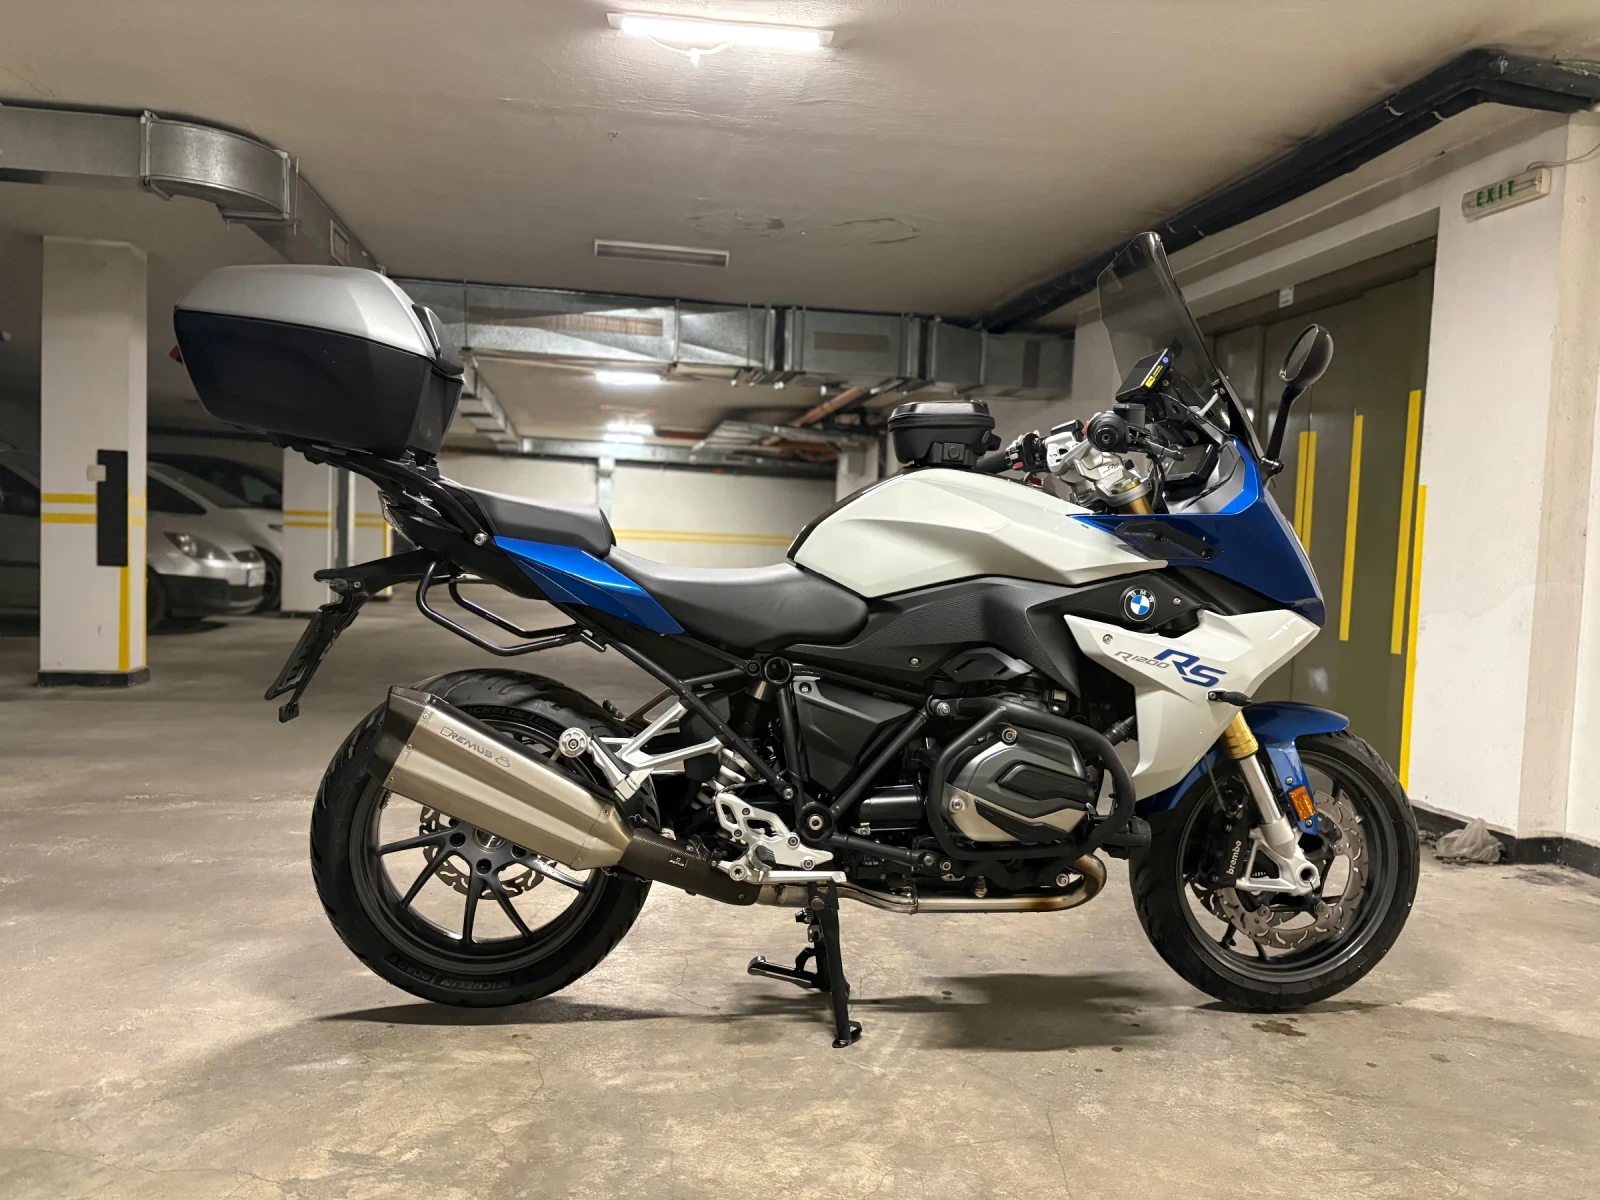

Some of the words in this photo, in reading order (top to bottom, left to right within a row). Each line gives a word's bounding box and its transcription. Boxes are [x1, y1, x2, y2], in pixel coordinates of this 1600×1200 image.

[1476, 180, 1514, 207] EXIT
[1130, 589, 1155, 603] BMW
[1114, 650, 1170, 669] R1200
[1153, 648, 1227, 688] RS
[446, 732, 493, 759] REMUS
[1225, 840, 1242, 875] brembo
[440, 977, 511, 990] MICHELIN
